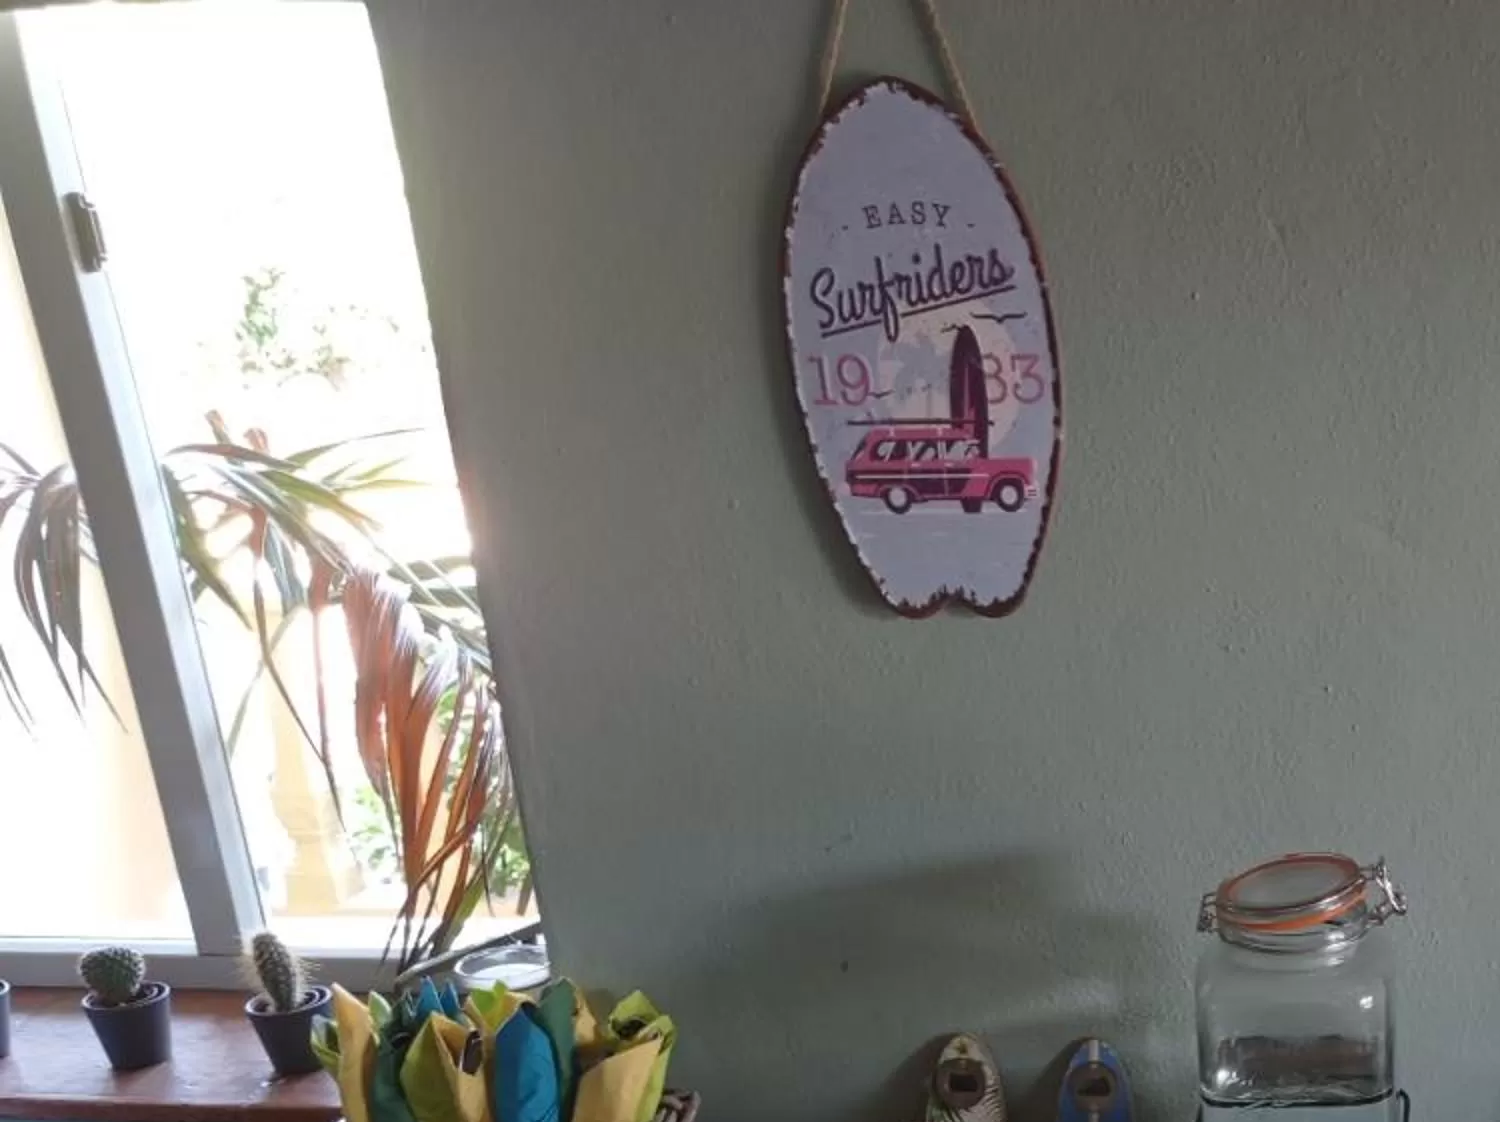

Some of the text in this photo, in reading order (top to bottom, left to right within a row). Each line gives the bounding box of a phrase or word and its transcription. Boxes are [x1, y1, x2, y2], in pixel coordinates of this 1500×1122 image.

[862, 201, 951, 229] EASY
[809, 243, 1015, 343] Surfriders
[808, 352, 871, 406] 19
